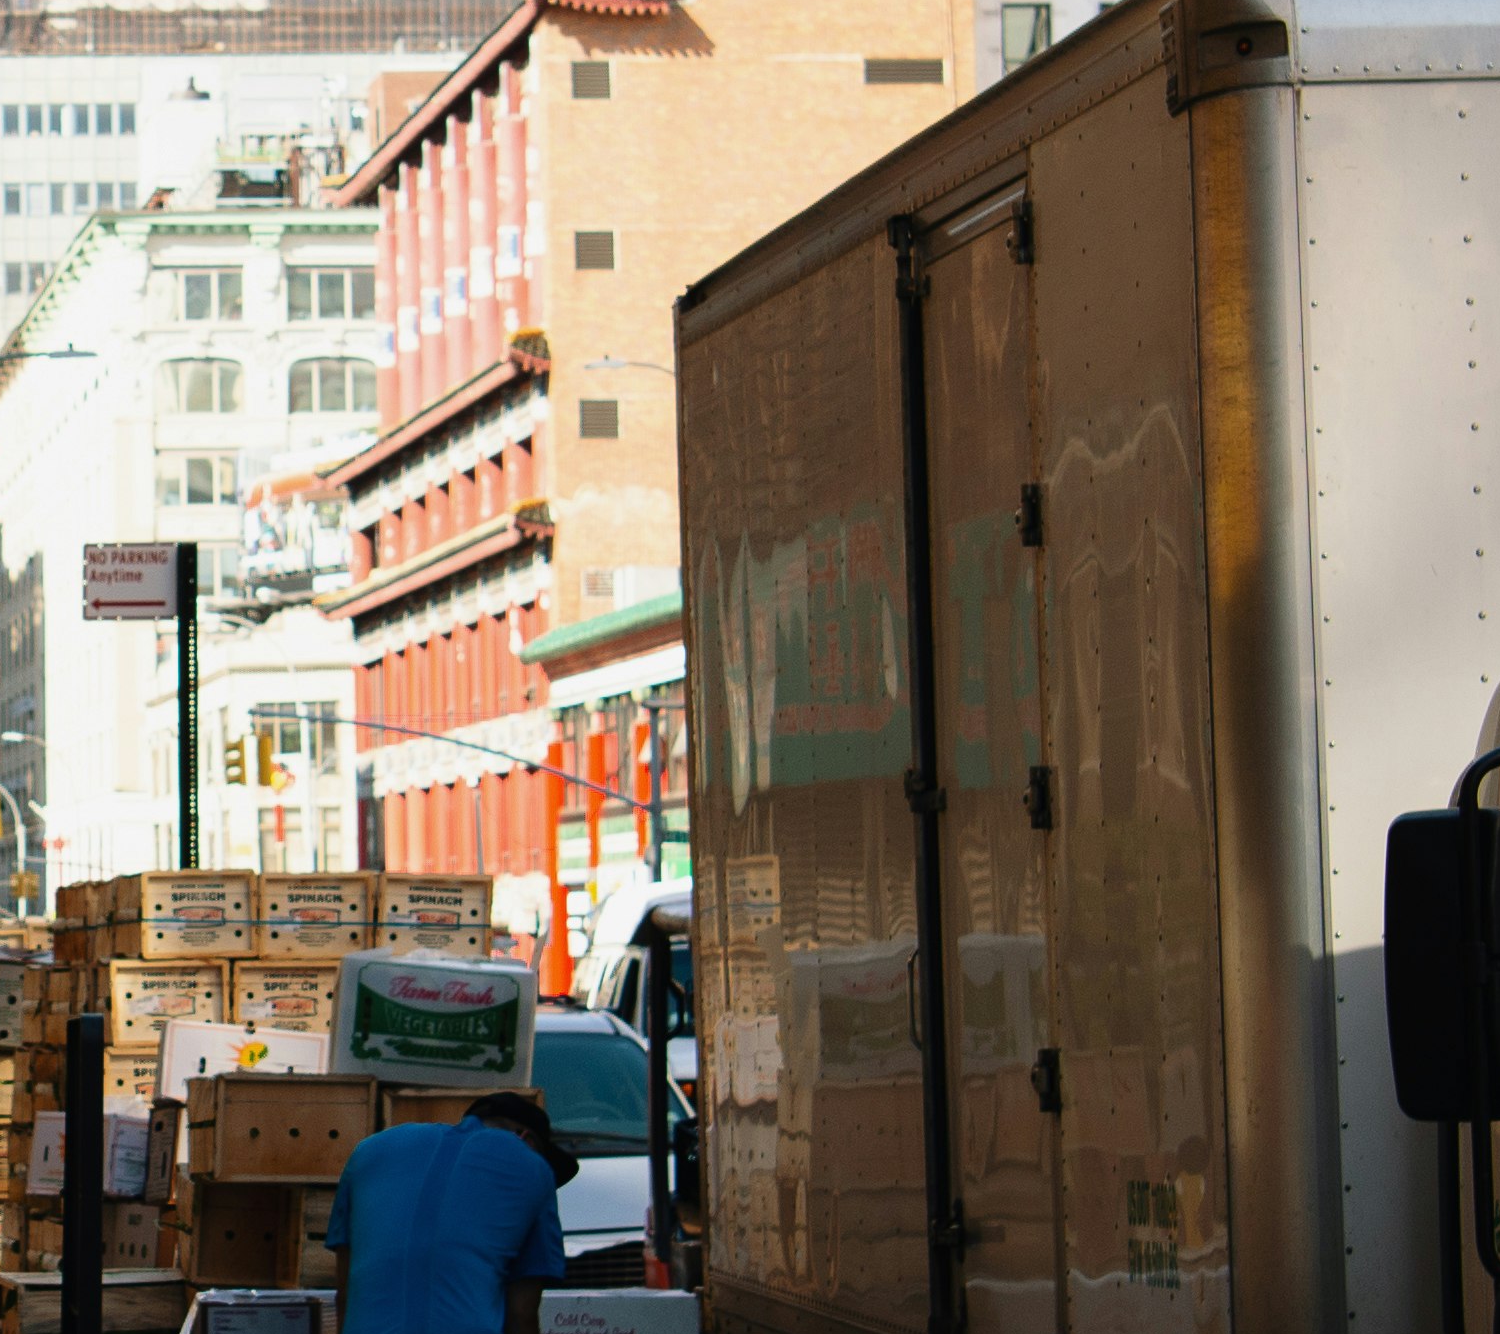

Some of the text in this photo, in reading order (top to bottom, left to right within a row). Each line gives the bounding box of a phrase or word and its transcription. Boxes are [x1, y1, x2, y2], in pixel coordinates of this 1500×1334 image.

[88, 549, 169, 565] NO PARKING
[88, 568, 143, 586] Anytime
